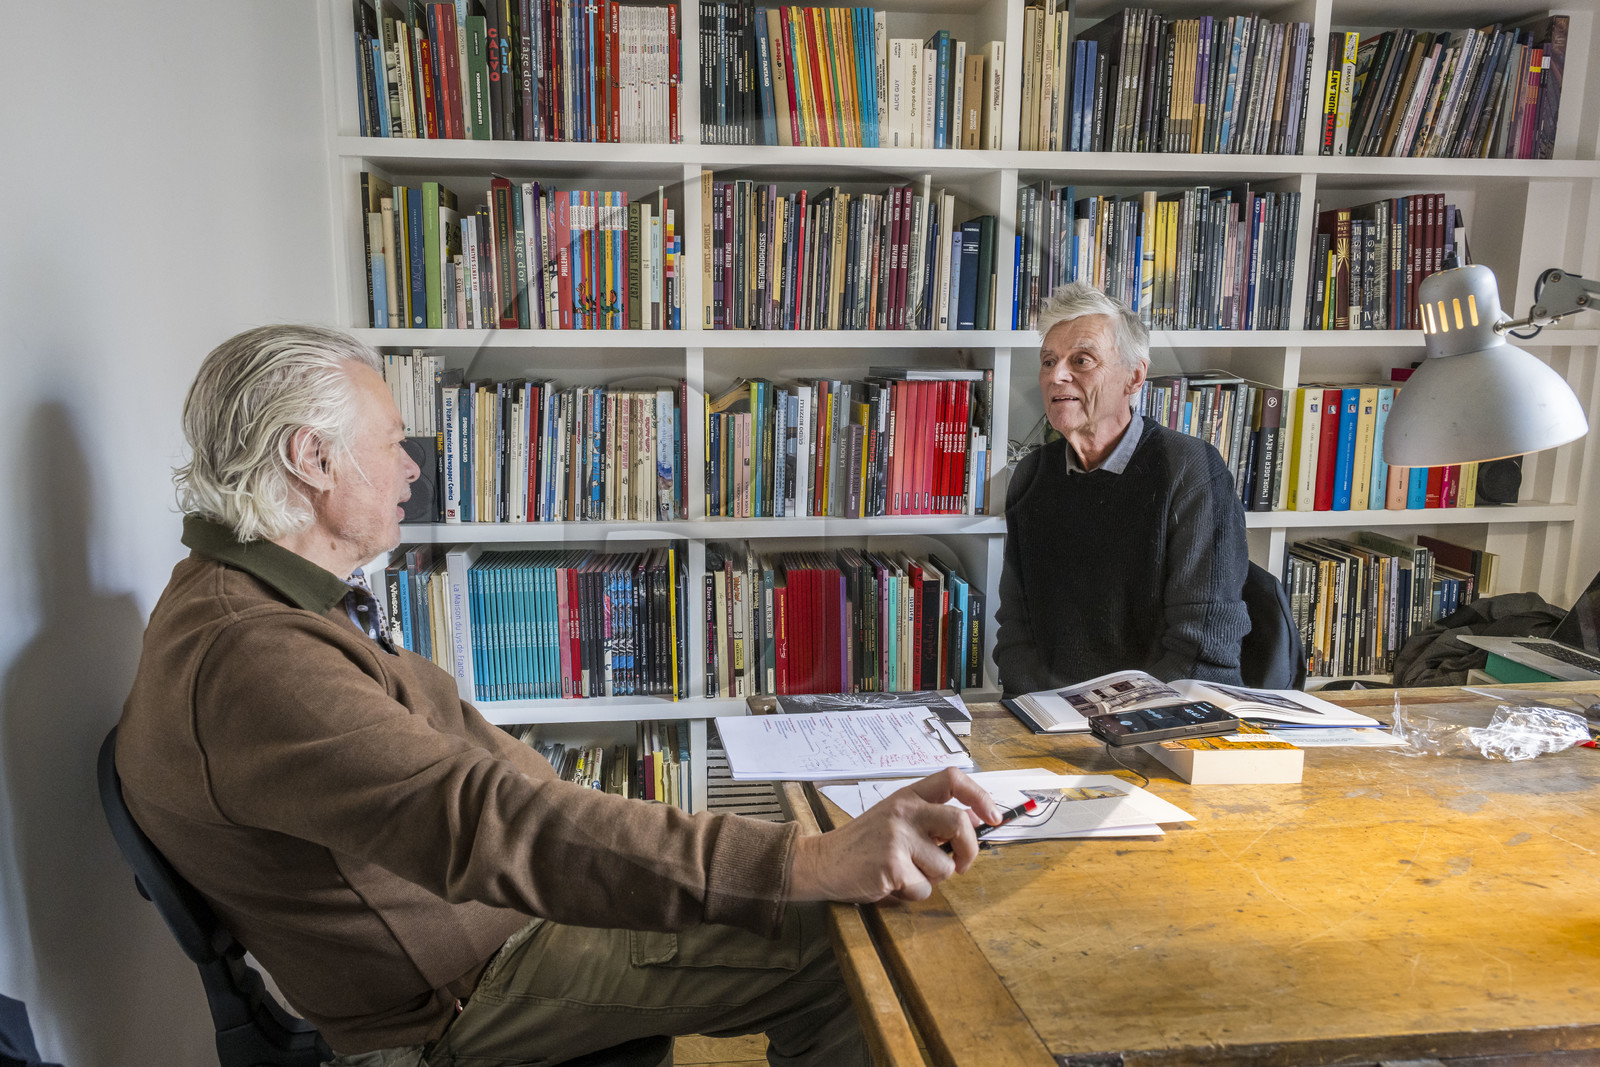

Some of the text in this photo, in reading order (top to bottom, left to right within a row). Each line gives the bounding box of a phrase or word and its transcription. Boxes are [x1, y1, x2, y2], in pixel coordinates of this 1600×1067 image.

[487, 28, 500, 83] CALVO
[523, 70, 532, 93] d'or
[911, 86, 916, 94] de
[446, 429, 454, 454] American
[447, 483, 455, 501] Comics
[453, 583, 461, 593] La
[454, 593, 462, 620] Maison
[454, 621, 462, 631] du
[457, 655, 466, 678] France
